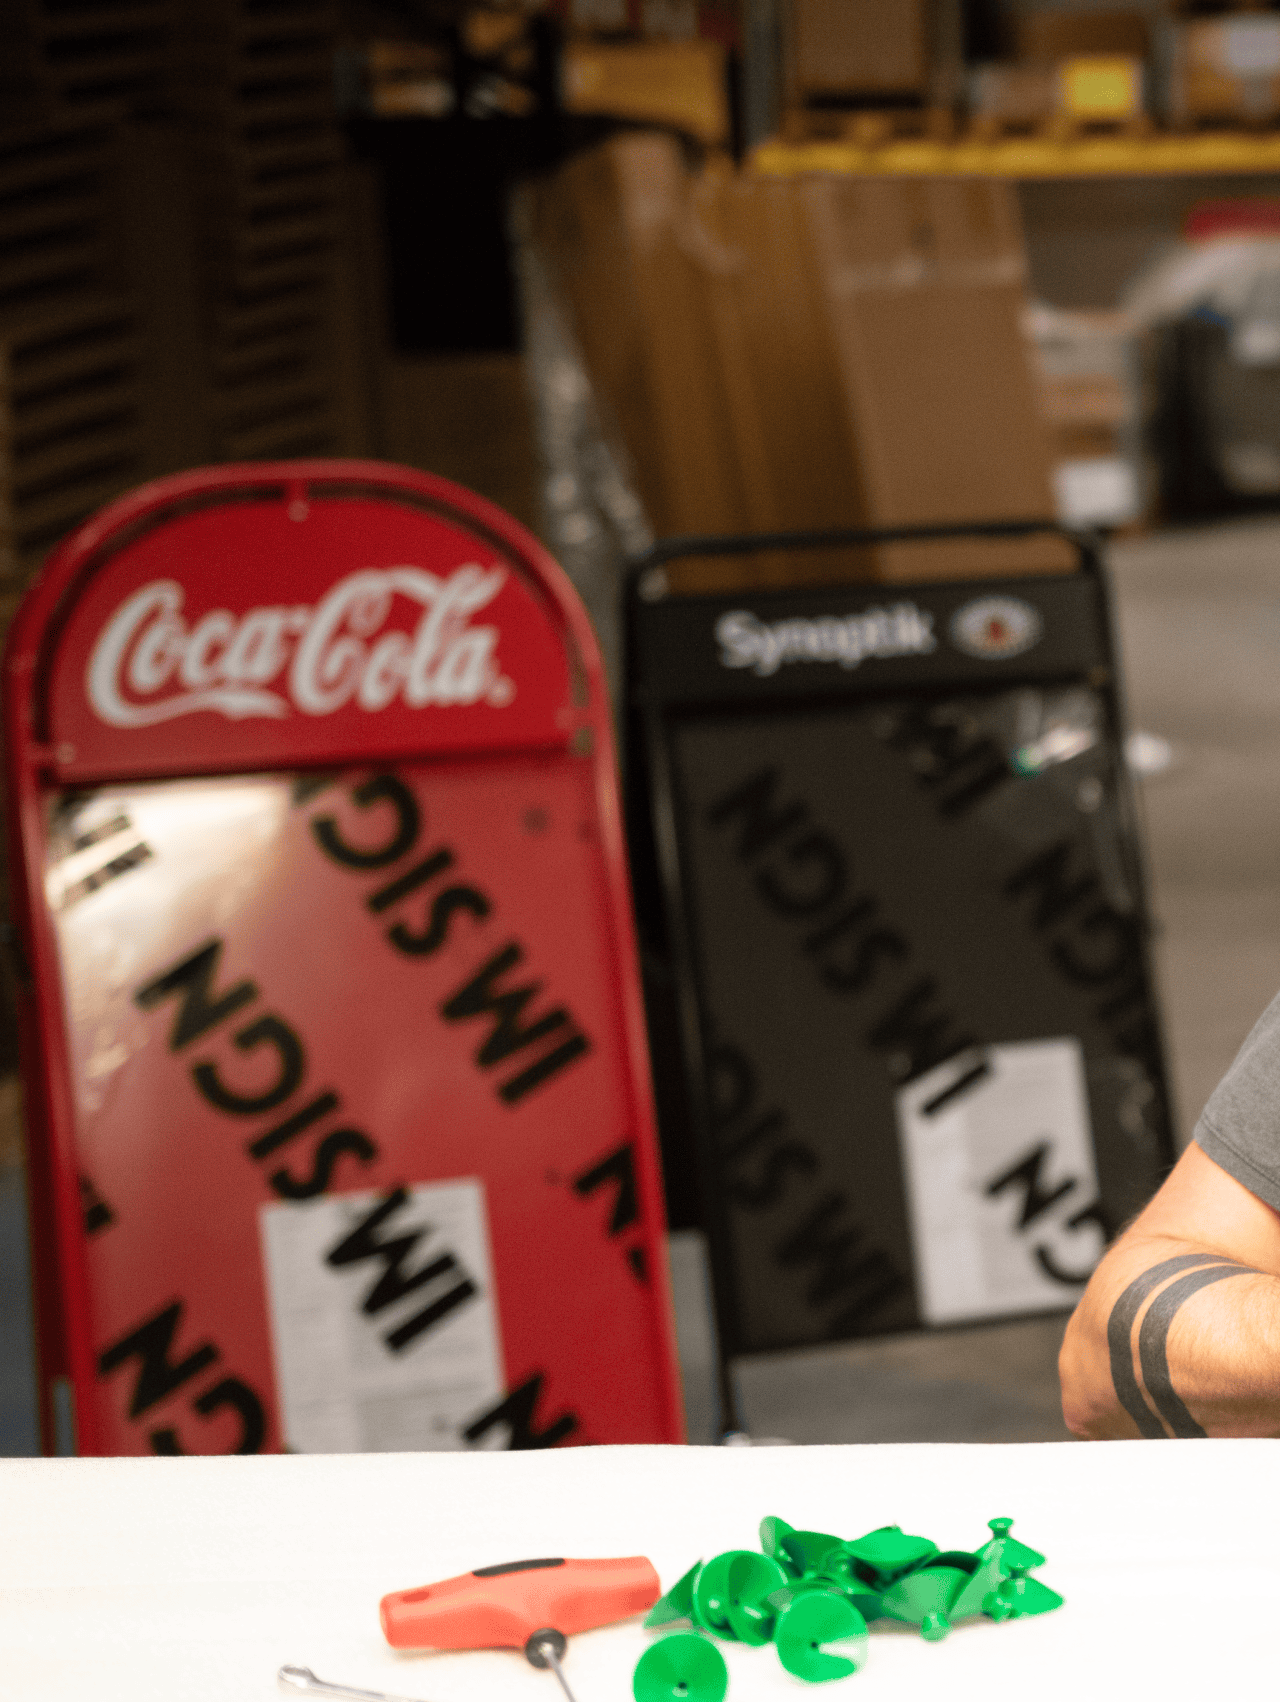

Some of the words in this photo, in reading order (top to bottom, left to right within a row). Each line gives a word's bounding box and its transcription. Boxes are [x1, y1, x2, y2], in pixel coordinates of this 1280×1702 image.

[87, 562, 511, 729] Coca-Cola
[717, 603, 936, 674] Synoptik
[293, 773, 491, 957] SIG
[707, 765, 909, 996] SIGN
[133, 937, 377, 1204] SIGN
[441, 942, 591, 1105] IM
[323, 1186, 478, 1355] IM
[777, 1191, 910, 1337] IM
